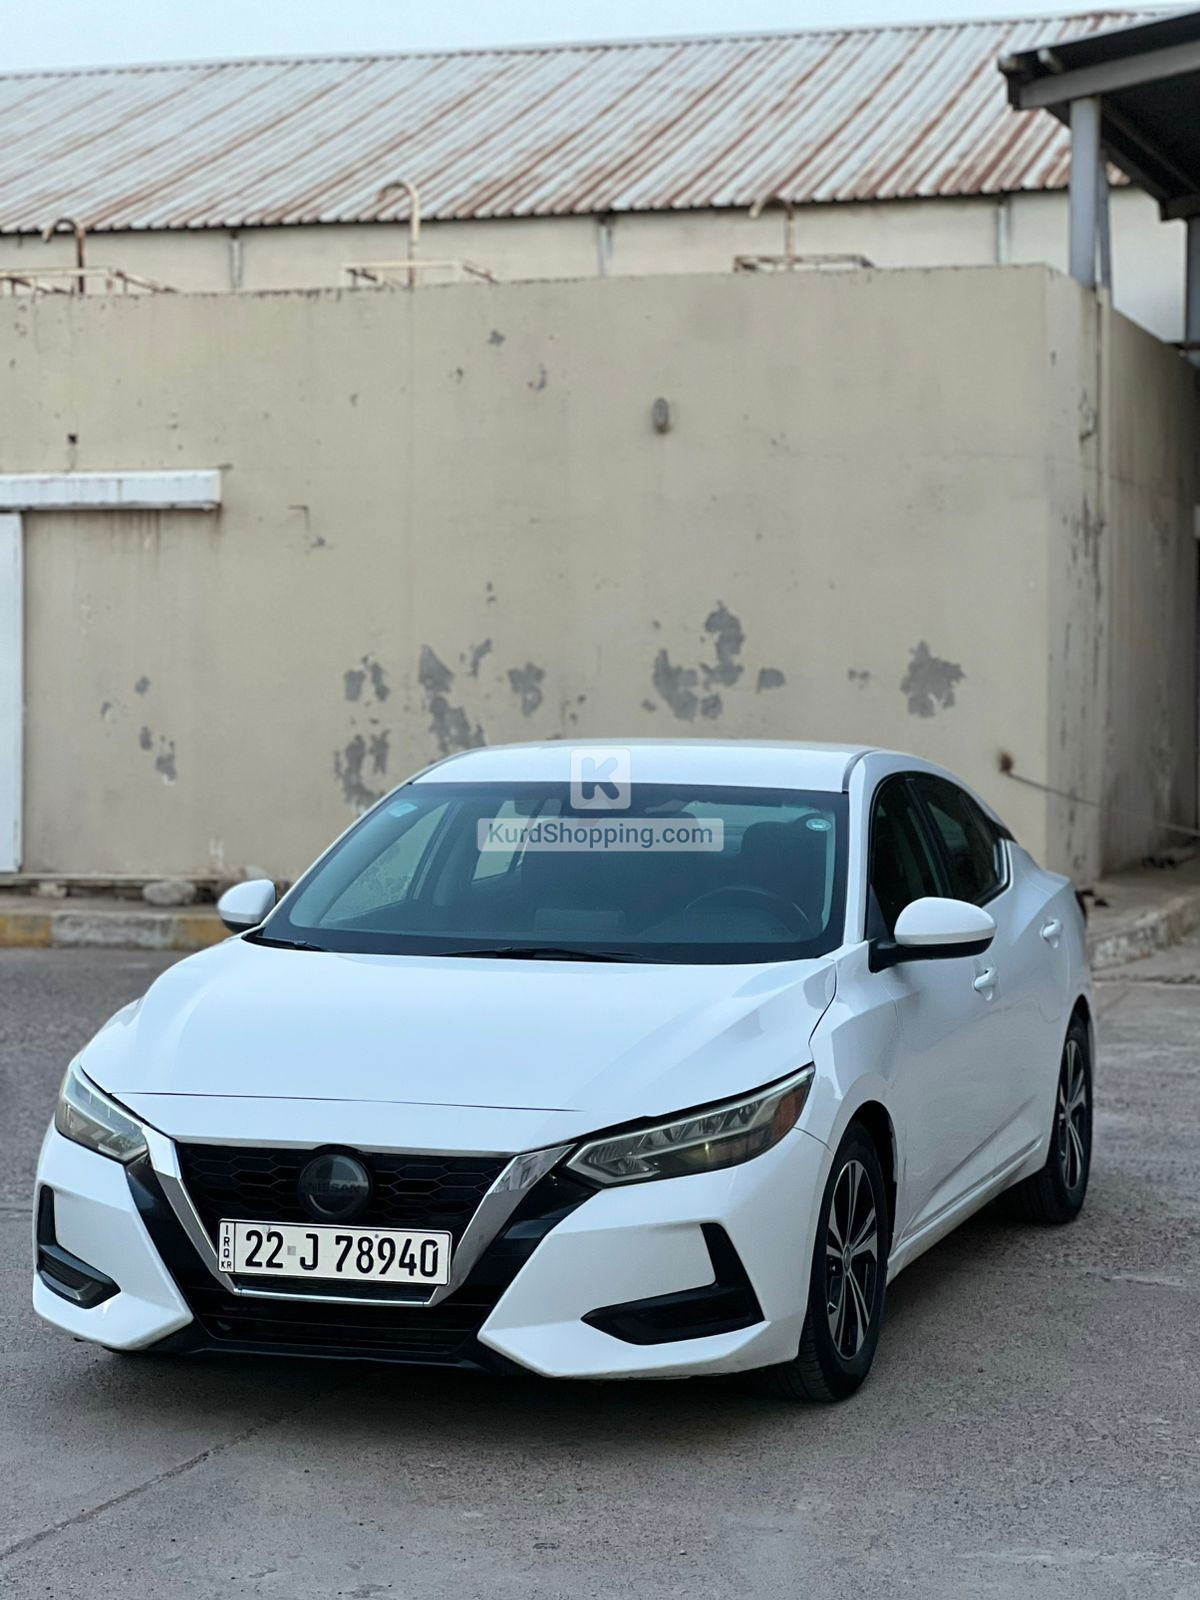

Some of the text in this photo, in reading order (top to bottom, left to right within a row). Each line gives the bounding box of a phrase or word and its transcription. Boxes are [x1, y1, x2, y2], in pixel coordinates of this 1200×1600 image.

[220, 1260, 232, 1269] KR
[245, 1229, 439, 1277] 22 J 78940
